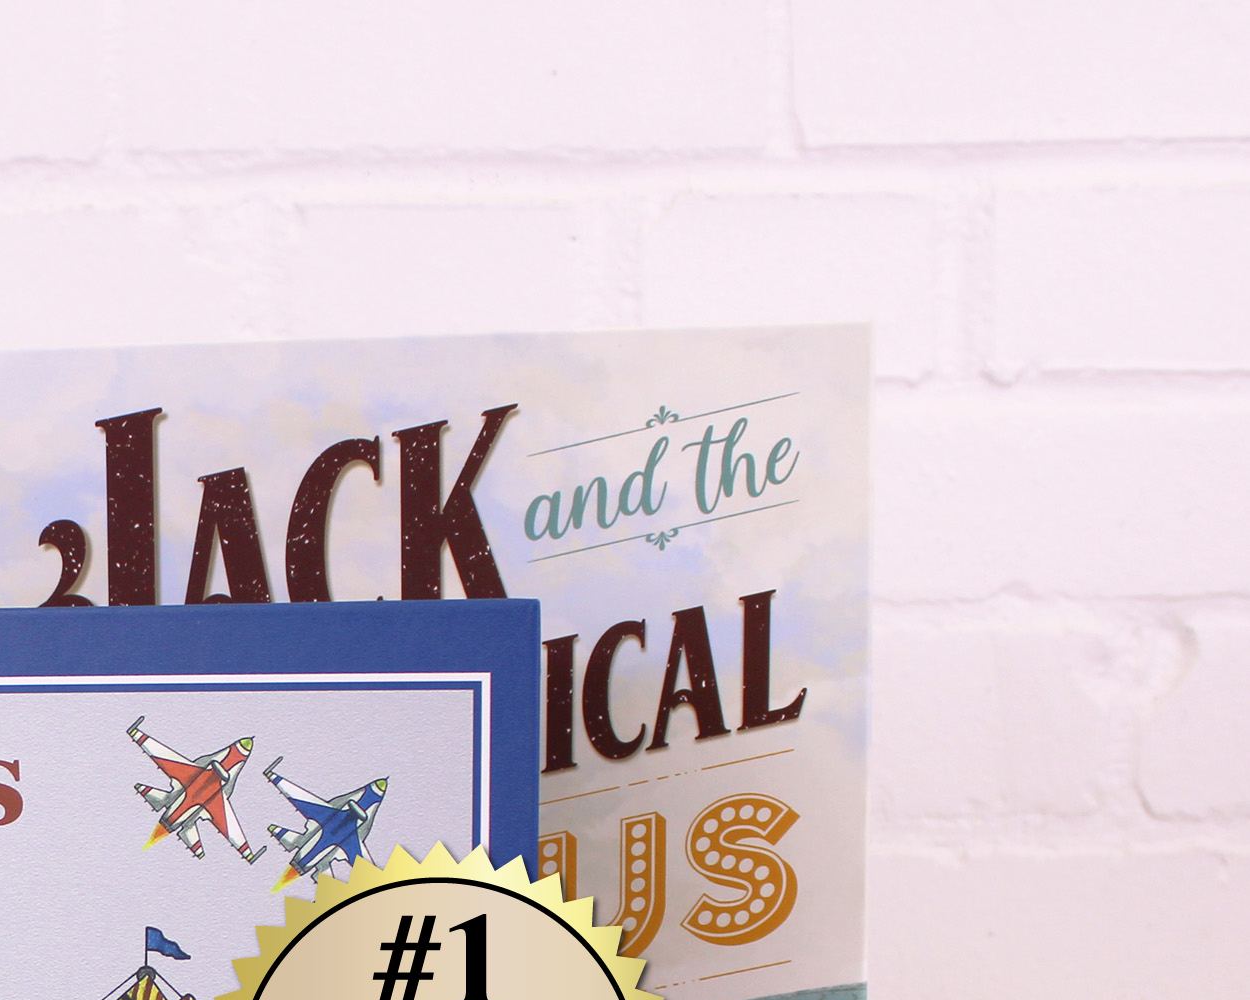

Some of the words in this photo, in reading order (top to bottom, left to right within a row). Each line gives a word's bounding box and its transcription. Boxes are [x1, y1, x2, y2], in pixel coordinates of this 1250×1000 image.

[39, 404, 517, 608] JACK
[524, 436, 670, 541] and
[682, 417, 800, 516] the
[540, 589, 808, 774] ICAL
